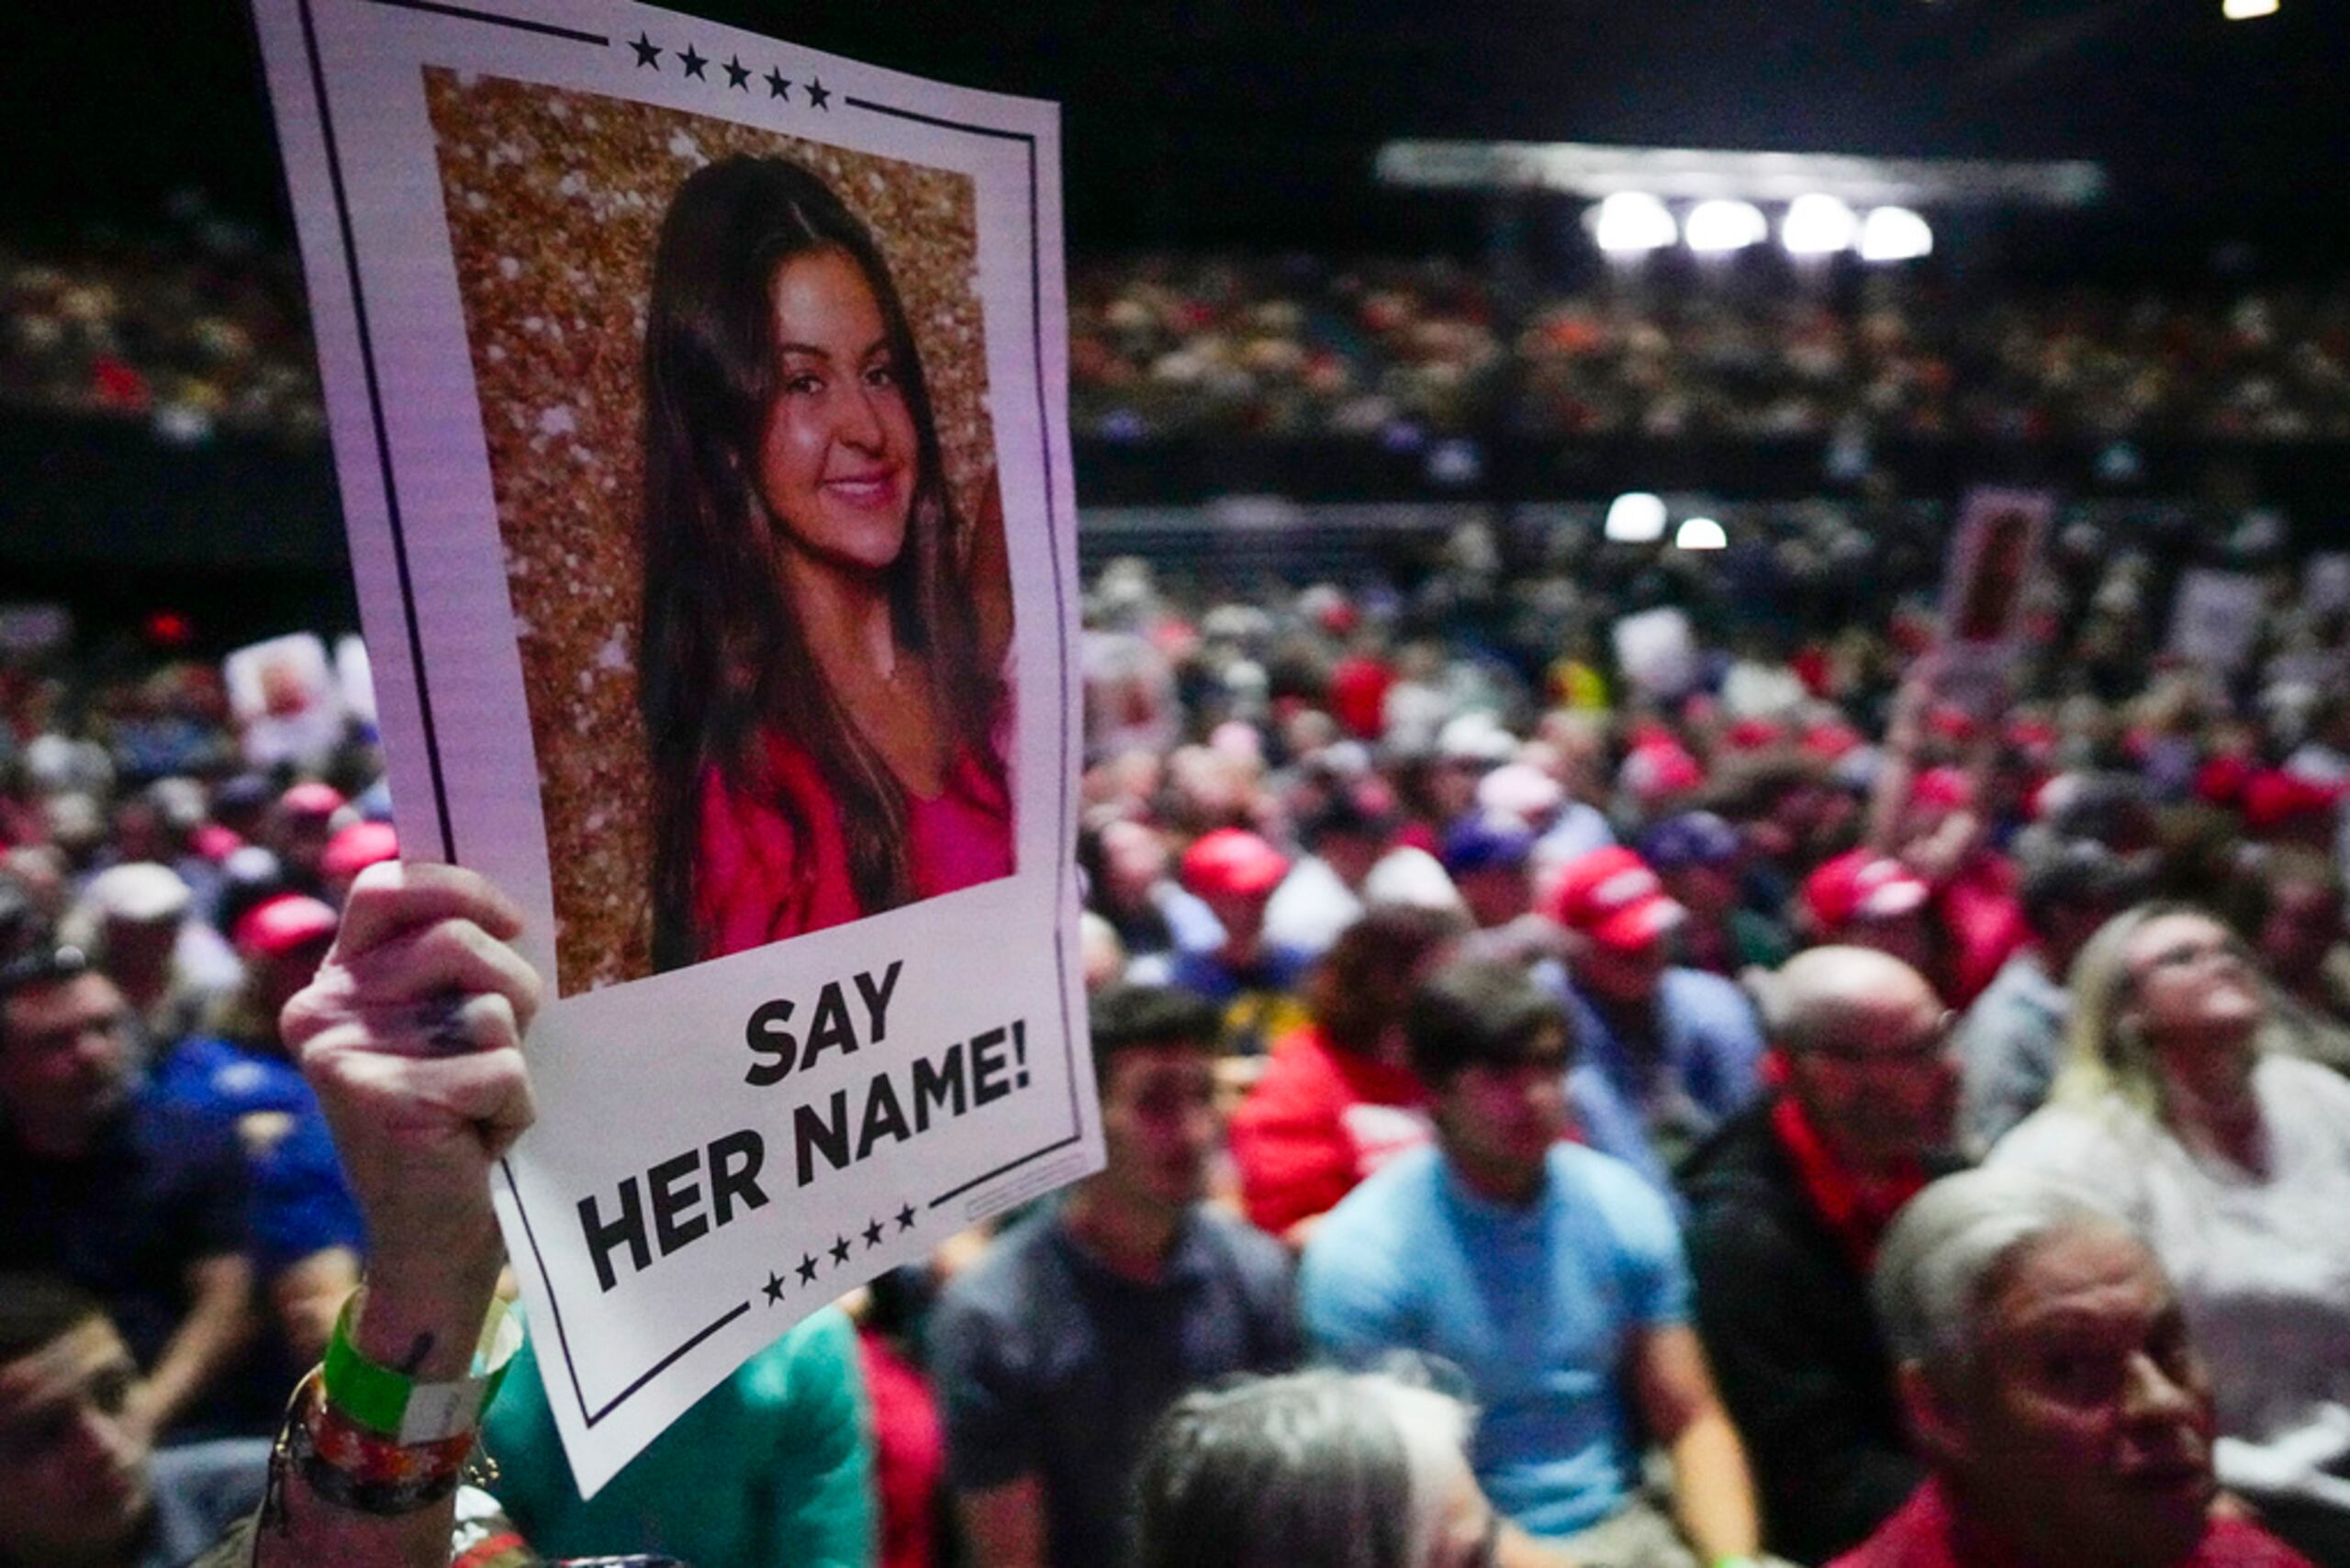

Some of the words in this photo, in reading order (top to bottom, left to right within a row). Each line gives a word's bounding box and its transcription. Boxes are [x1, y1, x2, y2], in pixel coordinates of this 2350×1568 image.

[744, 960, 903, 1086] SAY
[577, 1129, 769, 1293] HER
[793, 1019, 1030, 1187] NAME!
